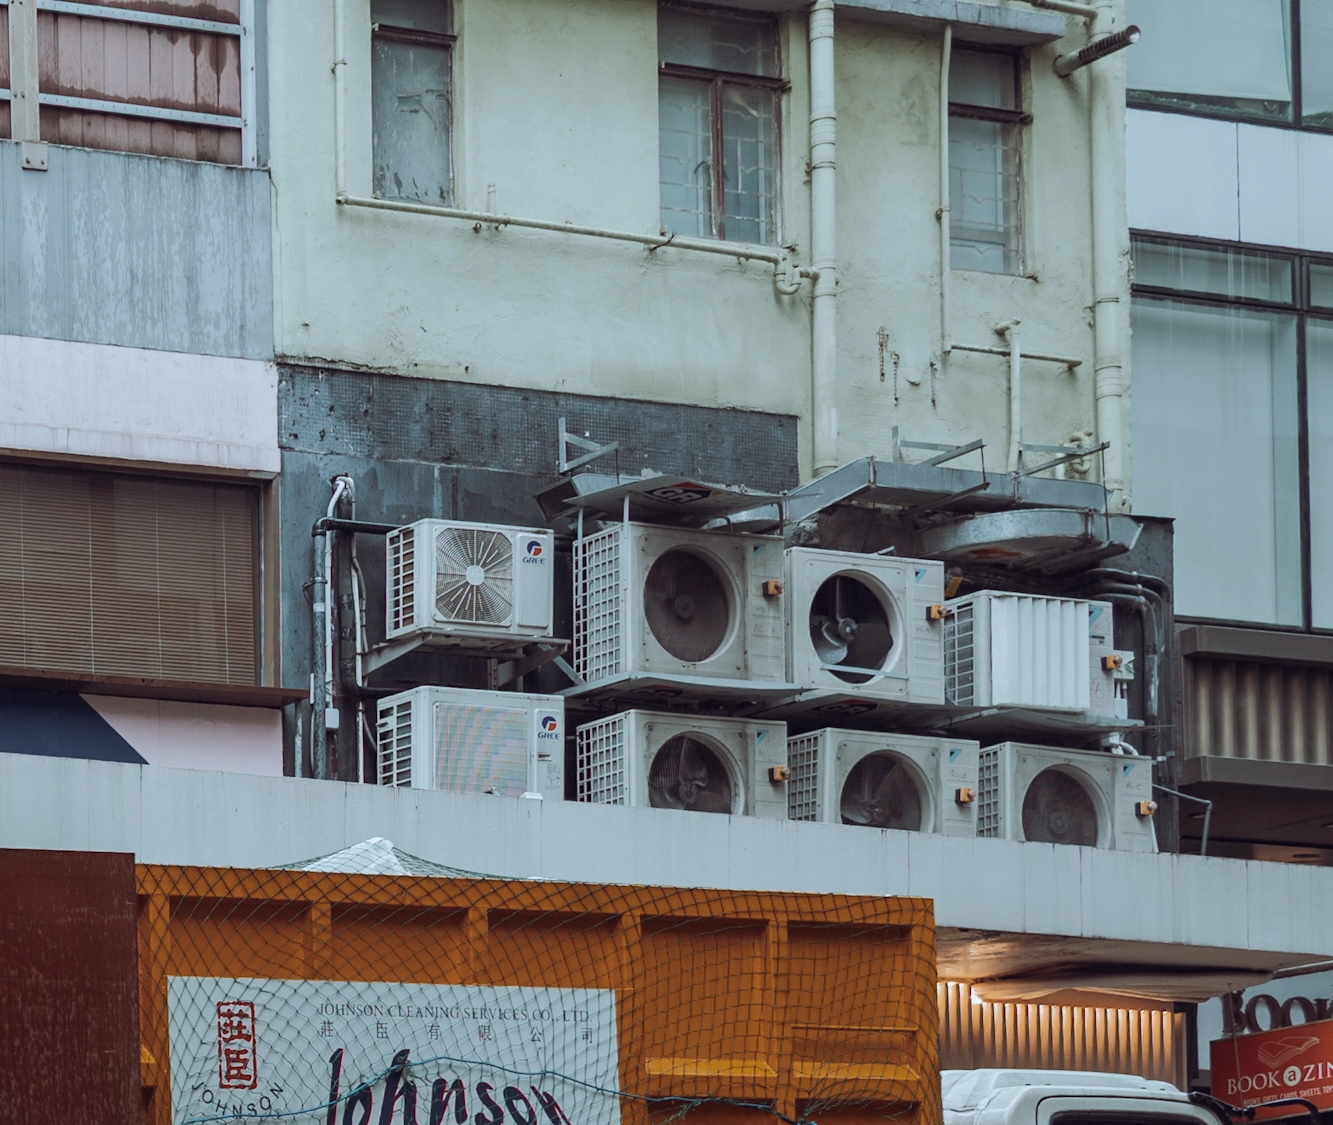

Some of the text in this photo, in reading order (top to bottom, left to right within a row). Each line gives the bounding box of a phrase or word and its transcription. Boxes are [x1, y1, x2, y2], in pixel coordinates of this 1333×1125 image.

[522, 557, 546, 565] GREE
[537, 731, 560, 740] GREE
[318, 1003, 384, 1017] JOHNSON
[388, 1004, 459, 1019] CLEANING
[465, 1007, 528, 1021] SERVICES
[563, 1010, 593, 1023] LTD.
[191, 1081, 284, 1118] JOHNSON
